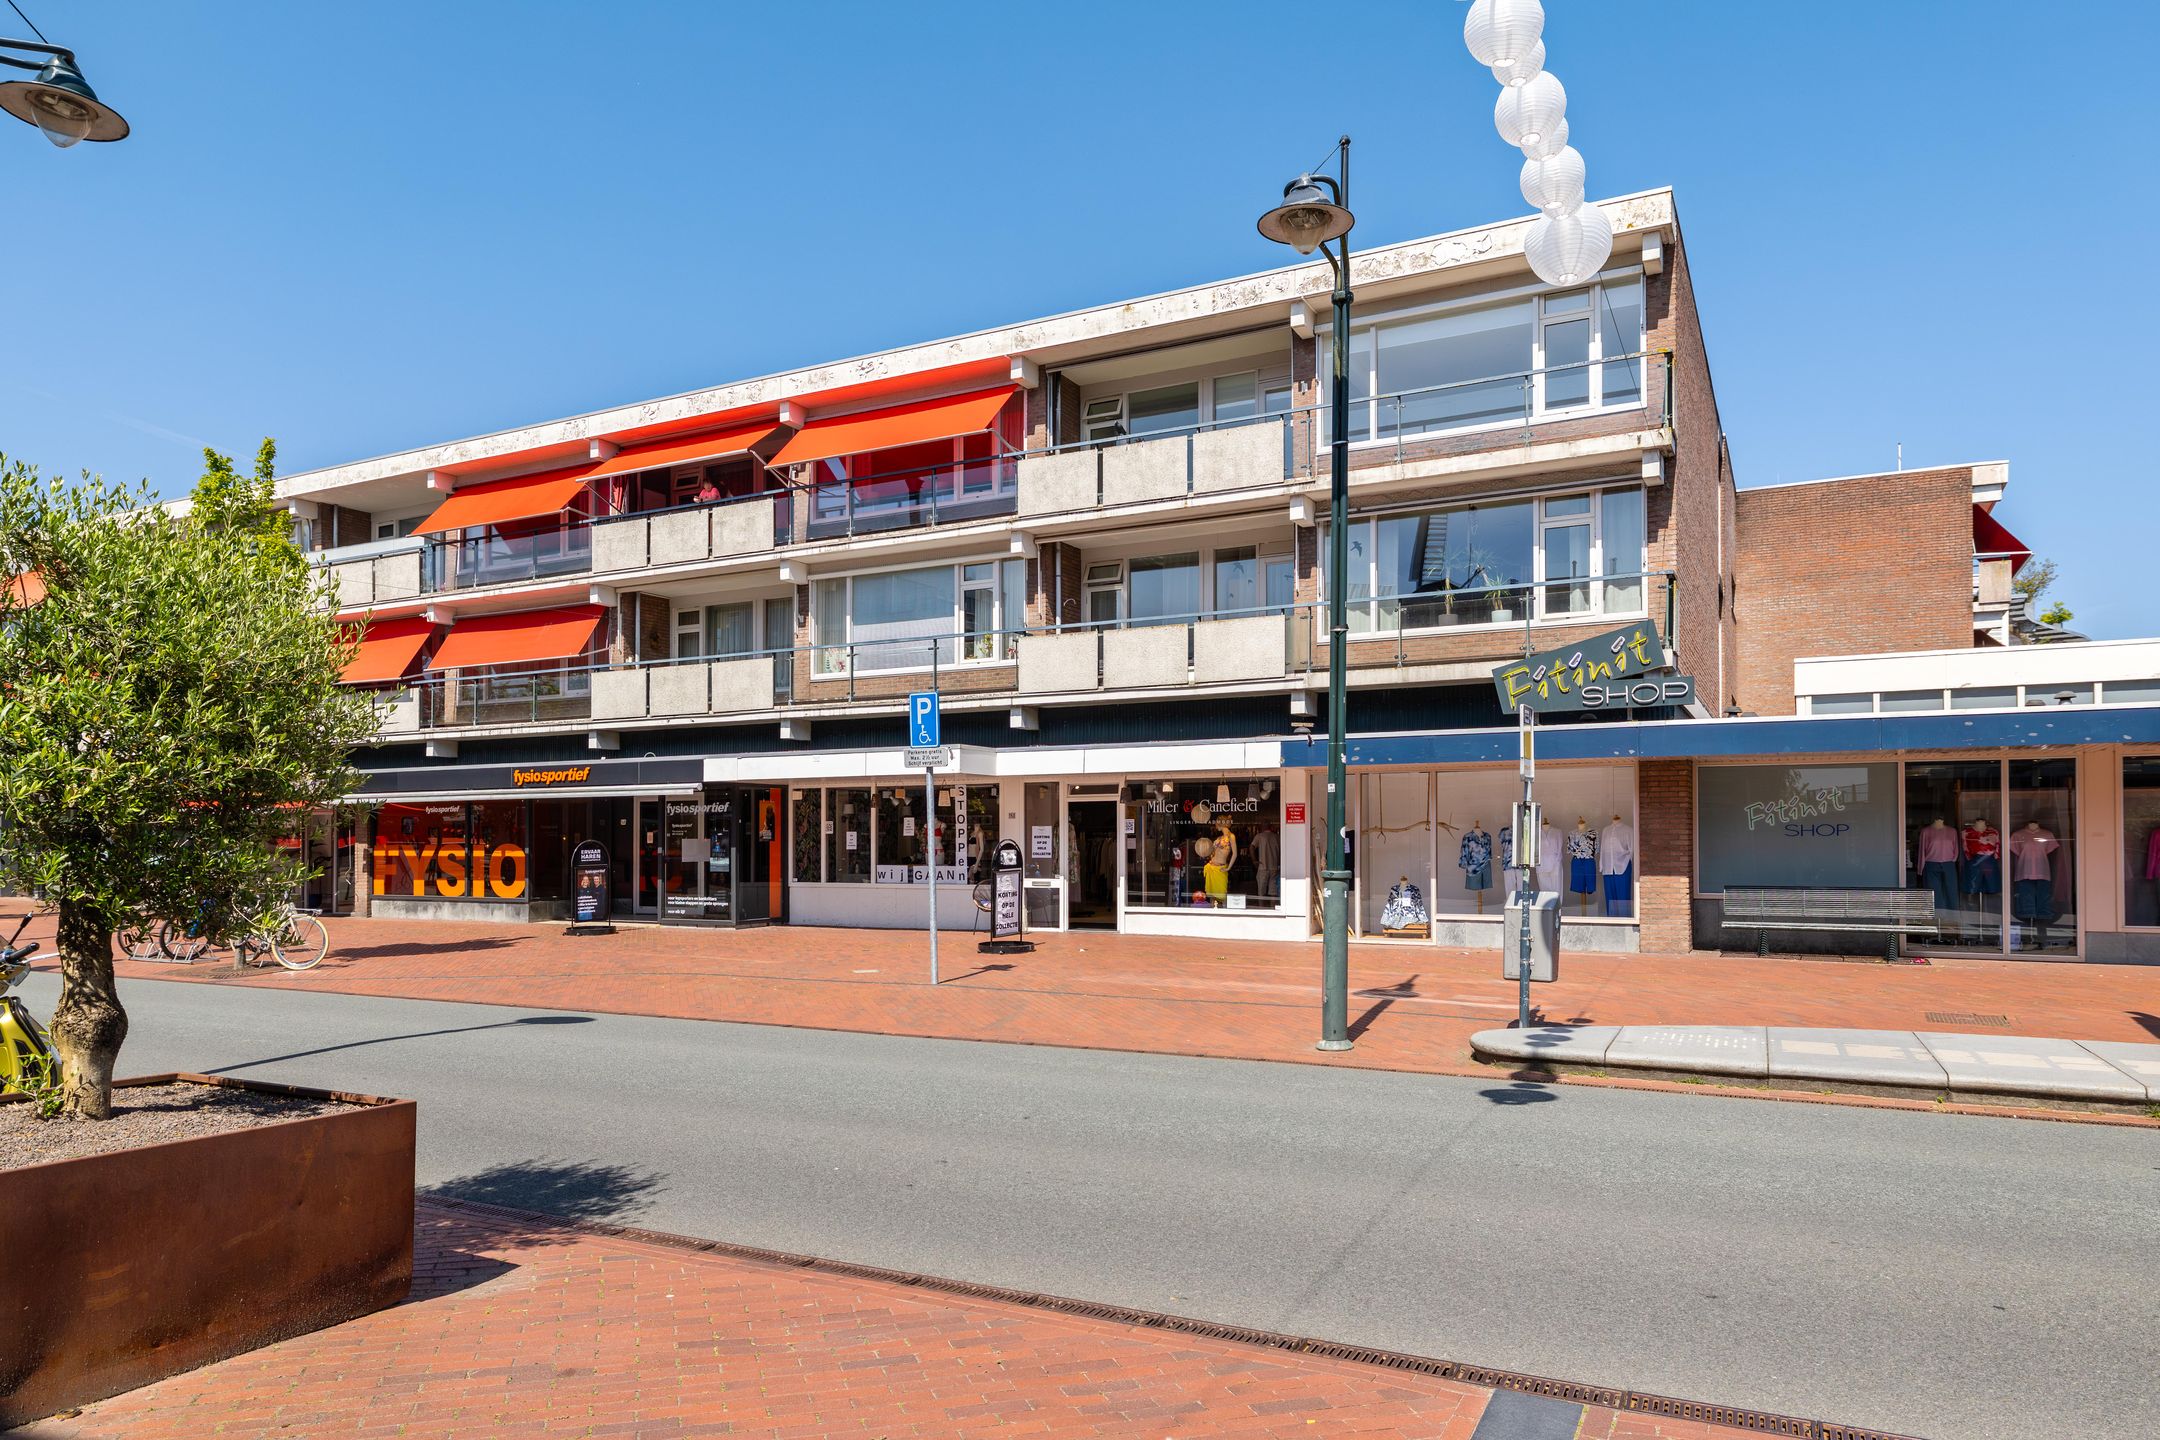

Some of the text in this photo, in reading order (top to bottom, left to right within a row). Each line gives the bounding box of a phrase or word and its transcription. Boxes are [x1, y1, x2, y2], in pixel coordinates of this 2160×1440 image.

[1502, 630, 1651, 710] Fitinit
[1582, 682, 1689, 706] SHOP
[917, 698, 932, 724] P
[513, 766, 592, 786] fysiosportief
[425, 805, 460, 814] fysiosportief
[667, 802, 730, 815] fysiosportief
[1147, 800, 1179, 813] Miller
[1200, 798, 1258, 812] Canefield
[1744, 787, 1846, 831] Fitinit
[1784, 823, 1849, 837] SHOP
[373, 843, 526, 899] FYSIO
[877, 869, 904, 882] wij
[998, 890, 1017, 898] KORTING
